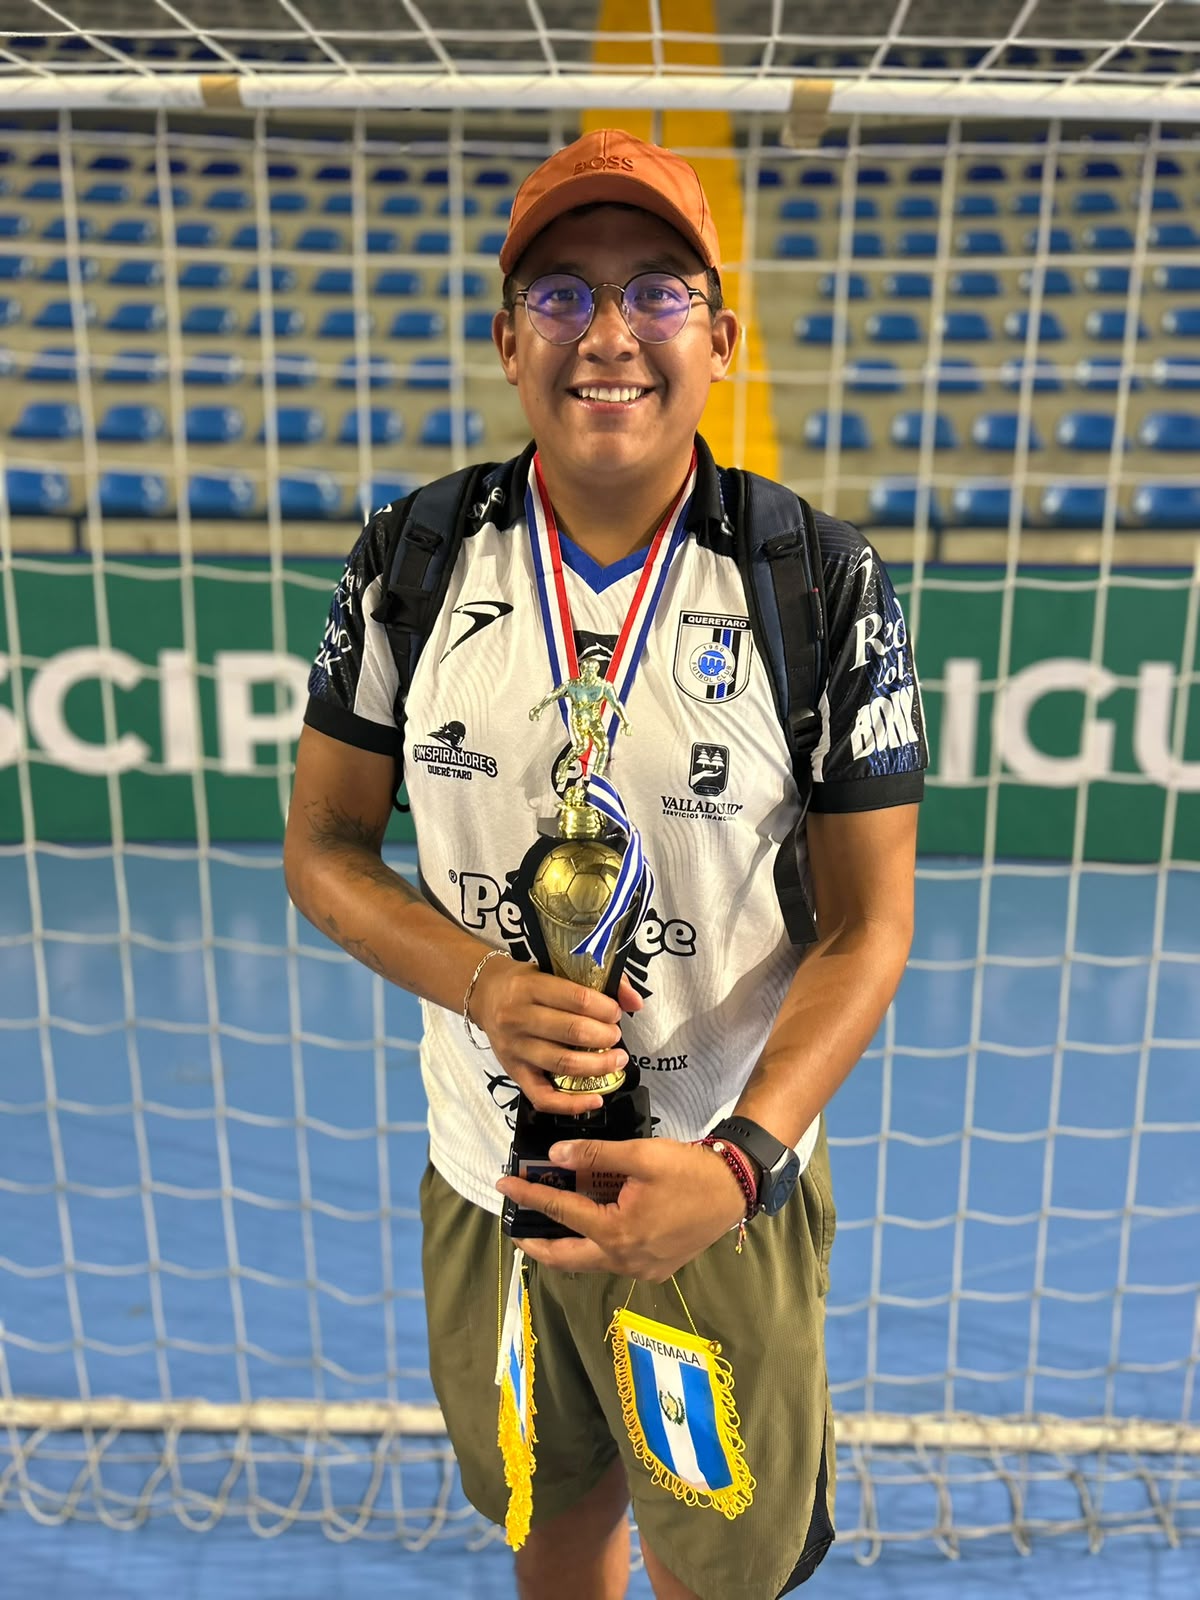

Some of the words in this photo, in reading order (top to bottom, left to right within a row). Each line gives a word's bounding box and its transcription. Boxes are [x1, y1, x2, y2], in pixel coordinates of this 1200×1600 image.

[573, 155, 635, 176] BOSS
[687, 615, 747, 628] QUERETARO
[0, 645, 311, 777] CIP
[413, 744, 498, 778] CONSPIRADORES
[662, 808, 699, 819] SERVICIOS
[630, 1330, 701, 1367] GUATEMALA
